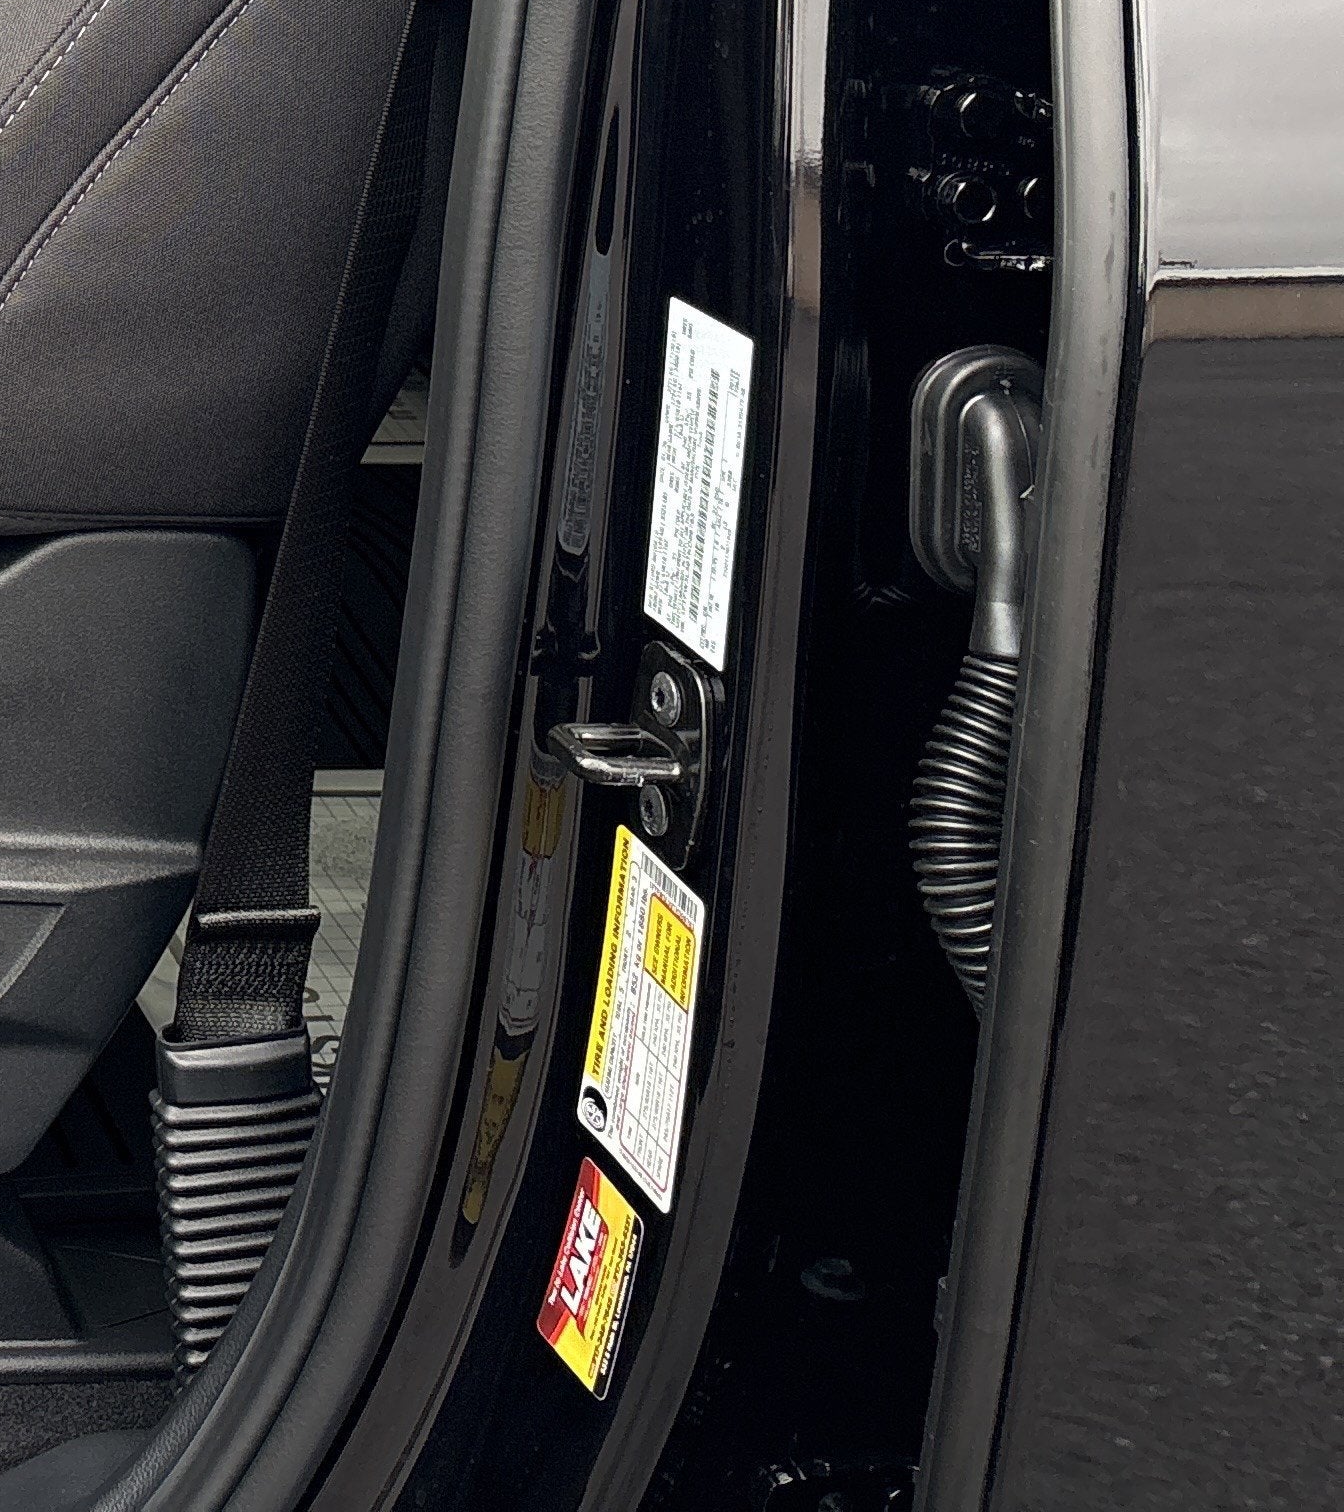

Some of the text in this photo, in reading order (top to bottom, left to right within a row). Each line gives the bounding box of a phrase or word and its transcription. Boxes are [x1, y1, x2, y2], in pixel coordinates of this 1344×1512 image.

[636, 938, 642, 952] or
[665, 921, 673, 943] FOR
[592, 837, 630, 1075] TIRE AND LOADING INFORMATION
[633, 952, 642, 970] kg
[678, 937, 693, 1005] INFORMATION
[560, 1197, 602, 1317] LAKE
